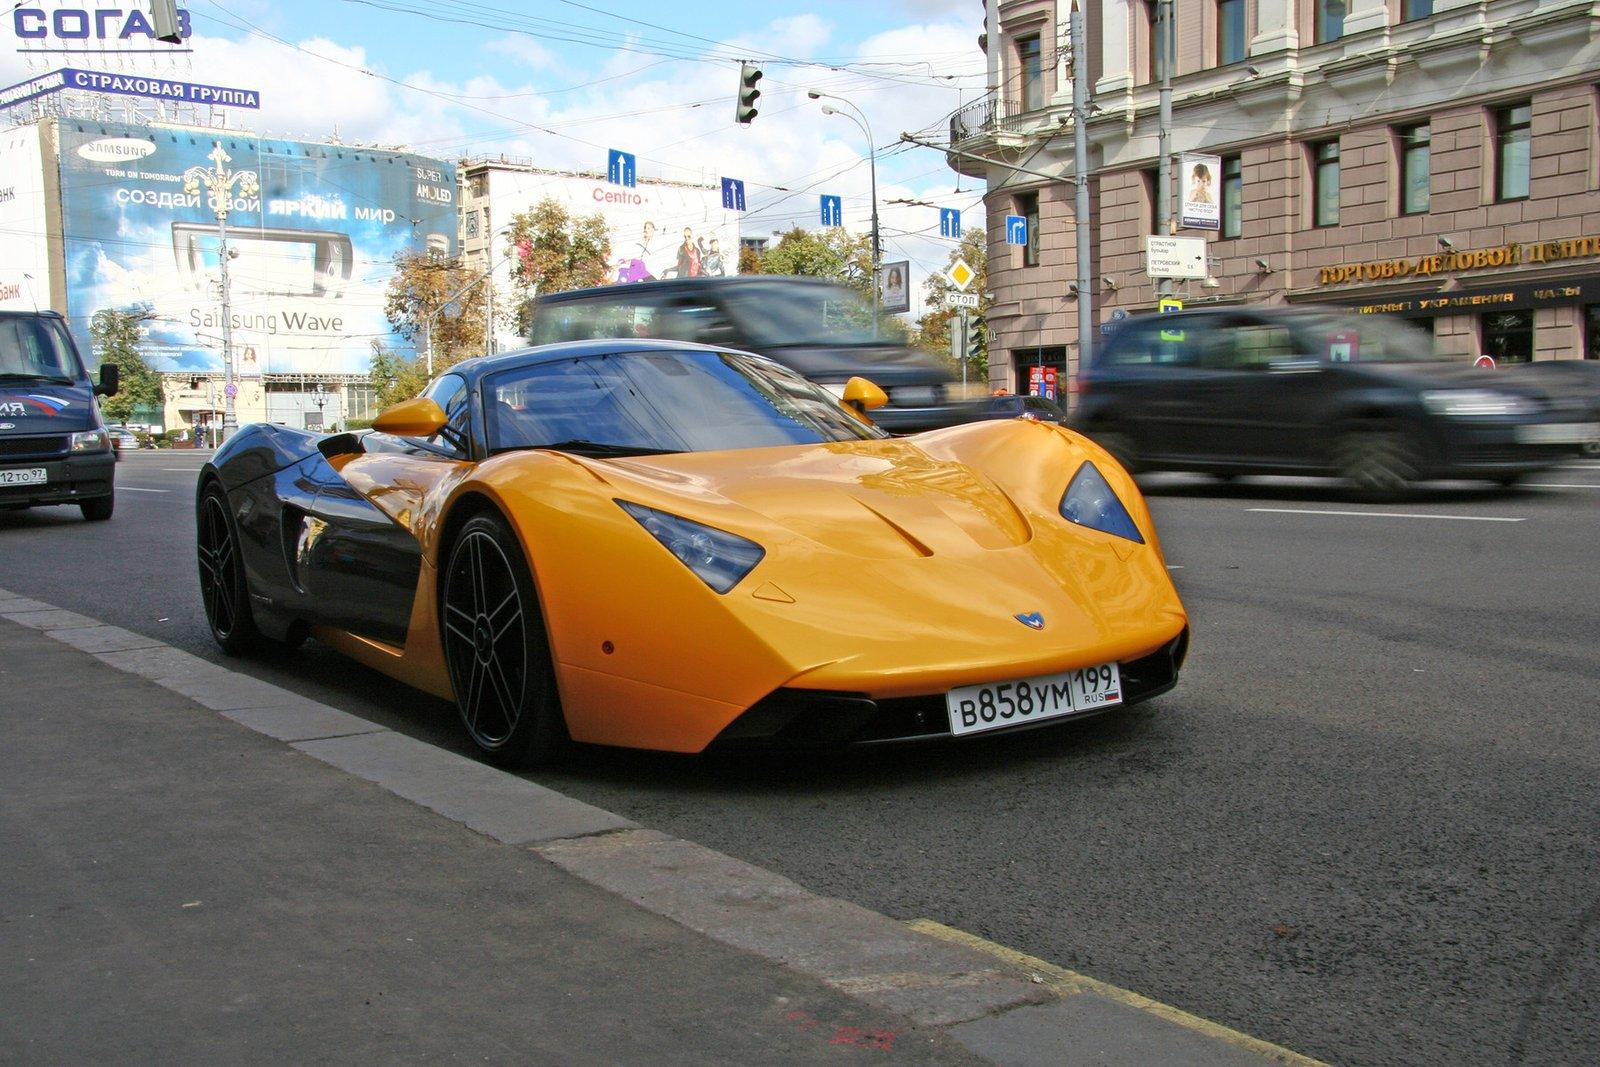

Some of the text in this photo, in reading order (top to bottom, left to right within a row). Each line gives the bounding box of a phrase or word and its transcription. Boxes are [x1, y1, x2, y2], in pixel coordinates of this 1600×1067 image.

[75, 72, 257, 106] СТРАХОВАЯ ГРУППА
[88, 142, 147, 157] SAMSUNG
[105, 168, 181, 182] TURN ON TOMORROW
[416, 167, 441, 182] SUPER
[416, 184, 452, 203] AMOLED
[592, 187, 642, 205] Centro
[355, 207, 395, 225] мир
[1320, 241, 1523, 285] ТОРГОВО-ДЕЛОВОЙ
[949, 294, 975, 305] СТОП
[1419, 292, 1515, 309] УКРАШЕНИЯ
[190, 308, 343, 334] Sasung Wave
[31, 469, 42, 478] 97
[1074, 664, 1112, 694] 199
[1084, 693, 1105, 704] RUS
